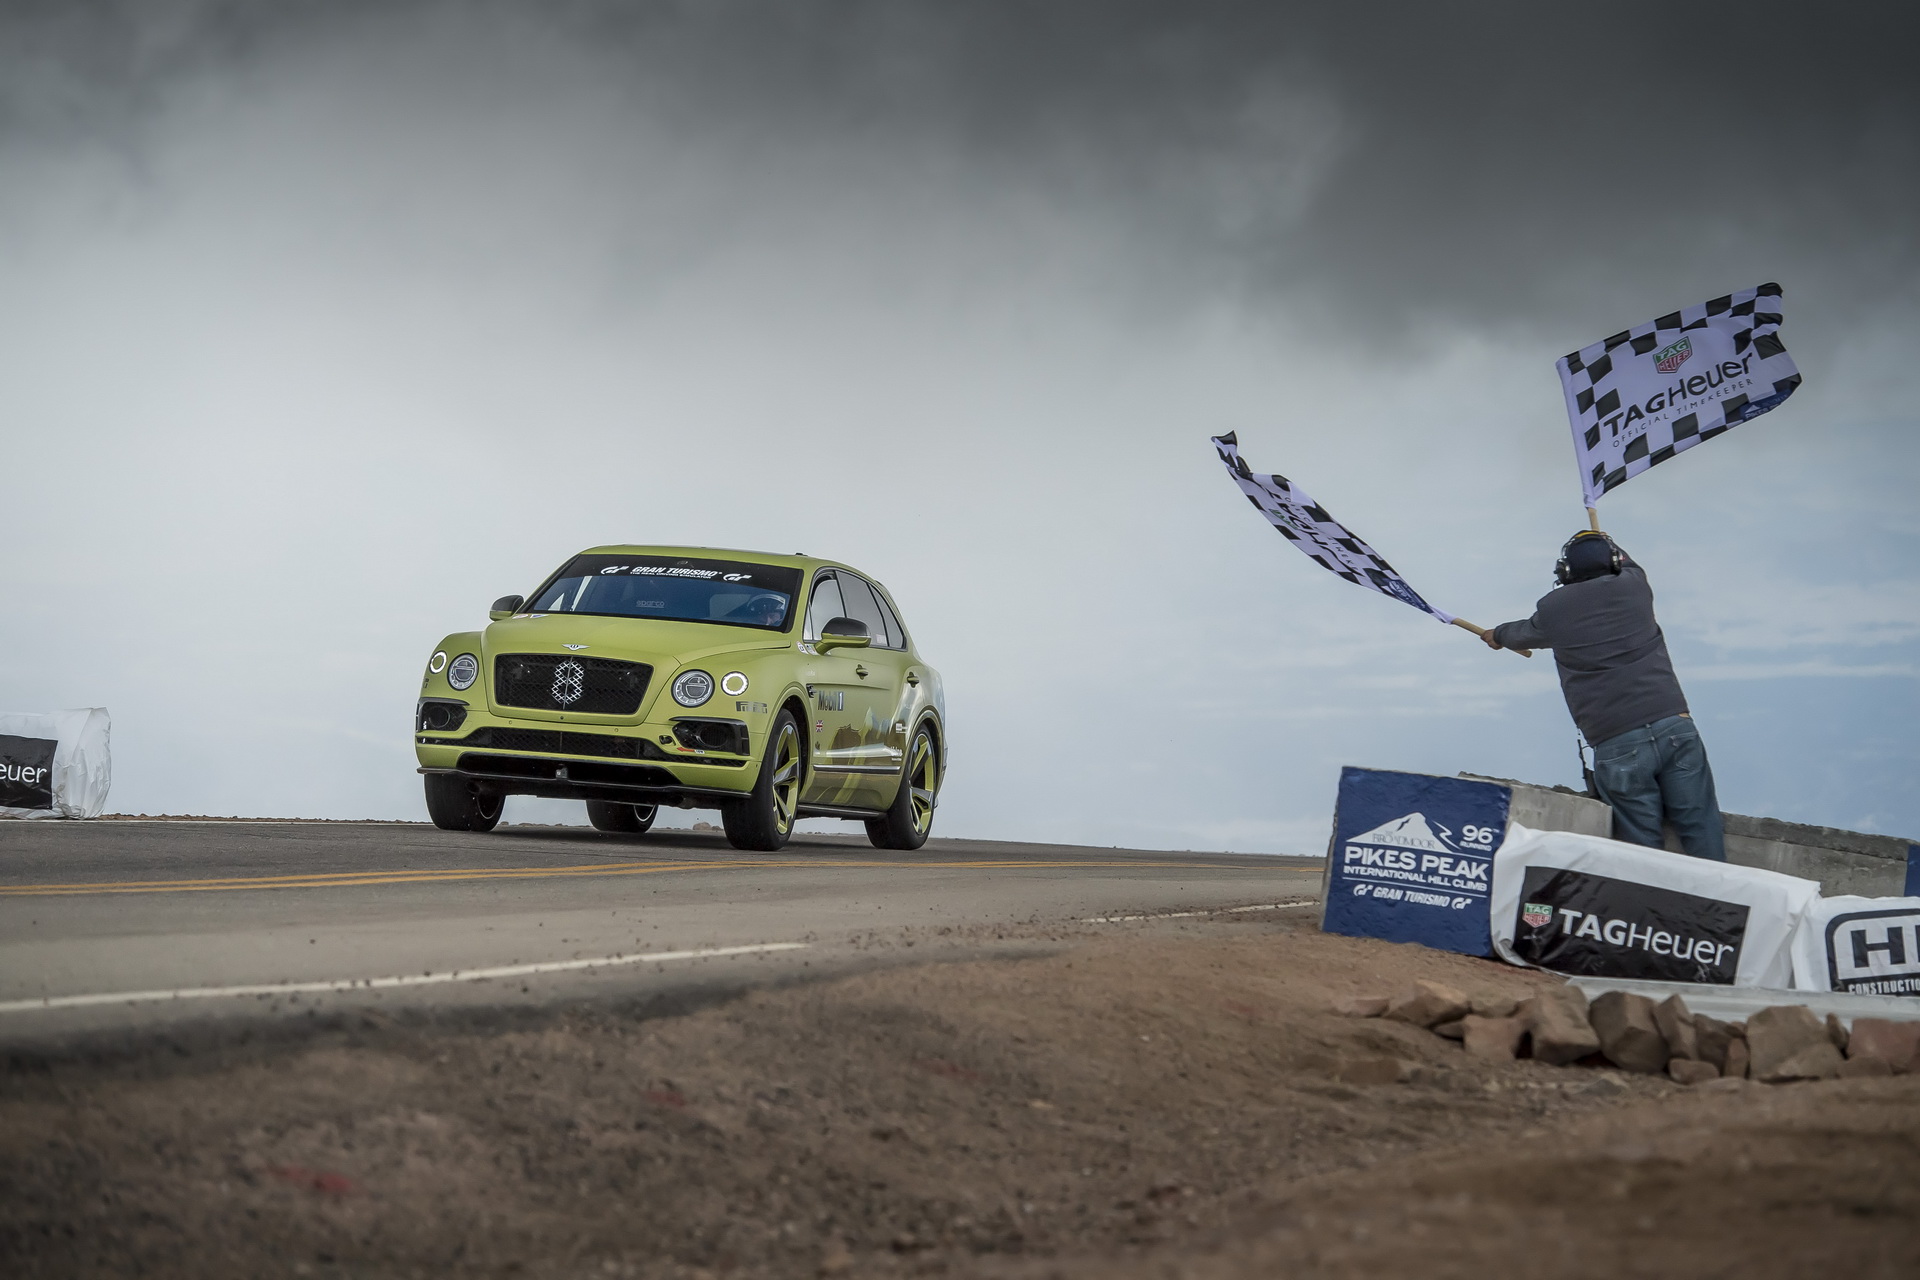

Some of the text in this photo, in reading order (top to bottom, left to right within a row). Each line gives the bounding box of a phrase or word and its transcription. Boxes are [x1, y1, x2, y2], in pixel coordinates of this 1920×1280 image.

[1657, 341, 1687, 359] TAG
[1659, 350, 1689, 370] HEUER
[1612, 379, 1754, 448] OFFICIAL TIMEKEEPER
[667, 567, 718, 577] TURISMO
[818, 690, 837, 711] Mobil
[1372, 833, 1436, 849] BROADMOOR
[1344, 846, 1489, 881] PIKES PEAK
[1343, 865, 1487, 892] INTERNATIONAL HILL CLIMB
[1373, 886, 1403, 900] GRAN
[1404, 890, 1450, 908] TURISMO
[1528, 905, 1550, 915] TAG
